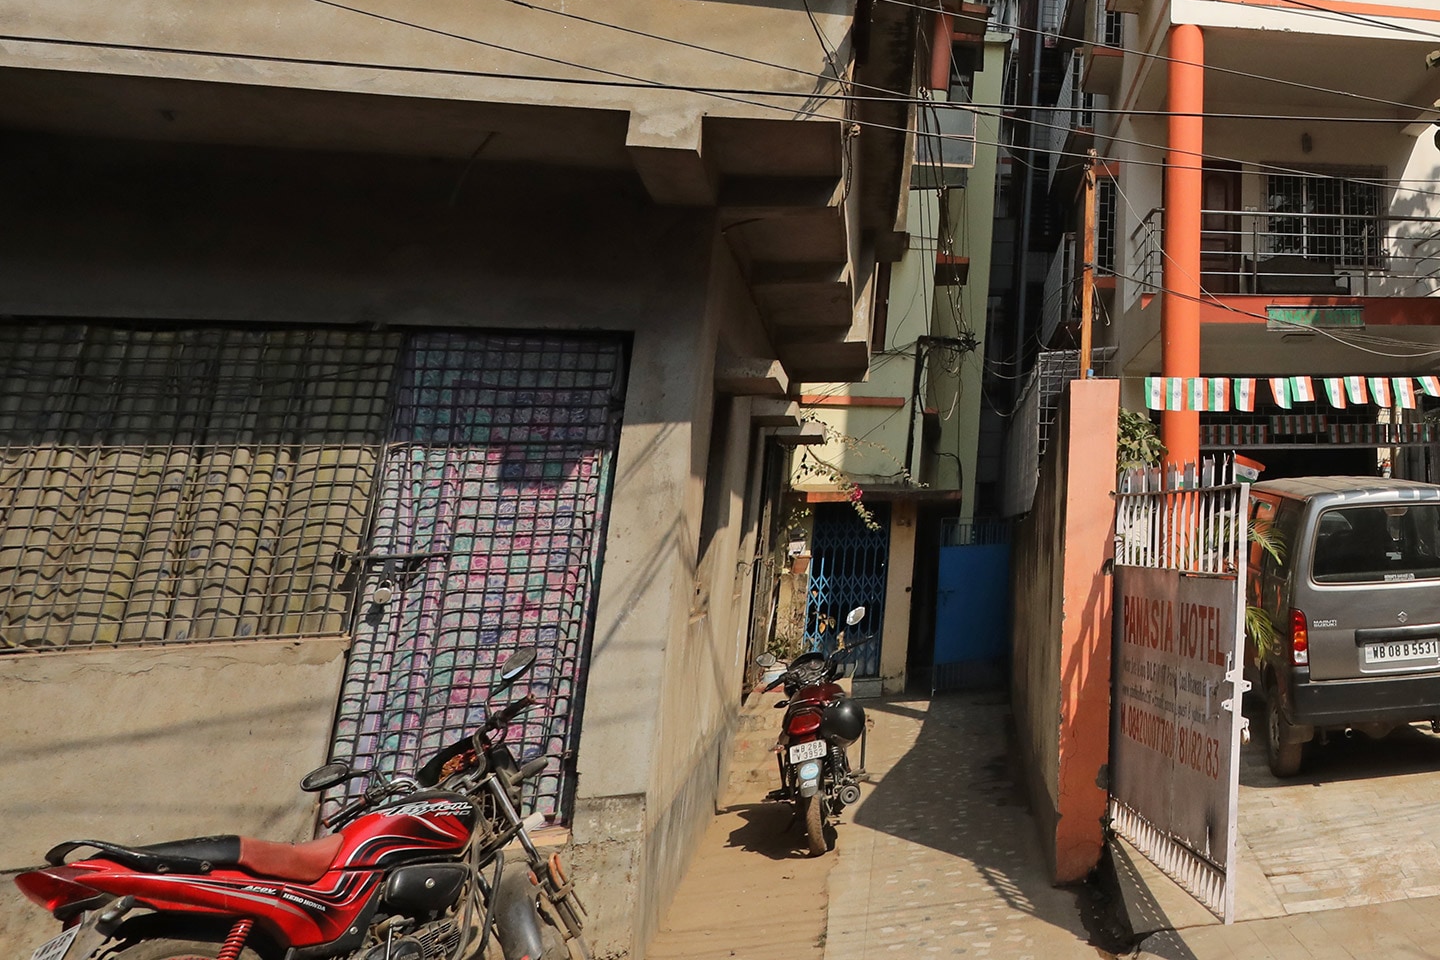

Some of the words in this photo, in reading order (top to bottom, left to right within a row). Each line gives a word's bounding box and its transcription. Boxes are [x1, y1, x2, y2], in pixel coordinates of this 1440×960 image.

[1123, 595, 1174, 653] PANASIA
[1179, 602, 1225, 667] HOTEL
[1388, 645, 1401, 657] 08
[1404, 644, 1410, 656] B
[1412, 641, 1437, 655] 5531
[283, 893, 304, 904] HERO
[303, 899, 326, 912] HONDA
